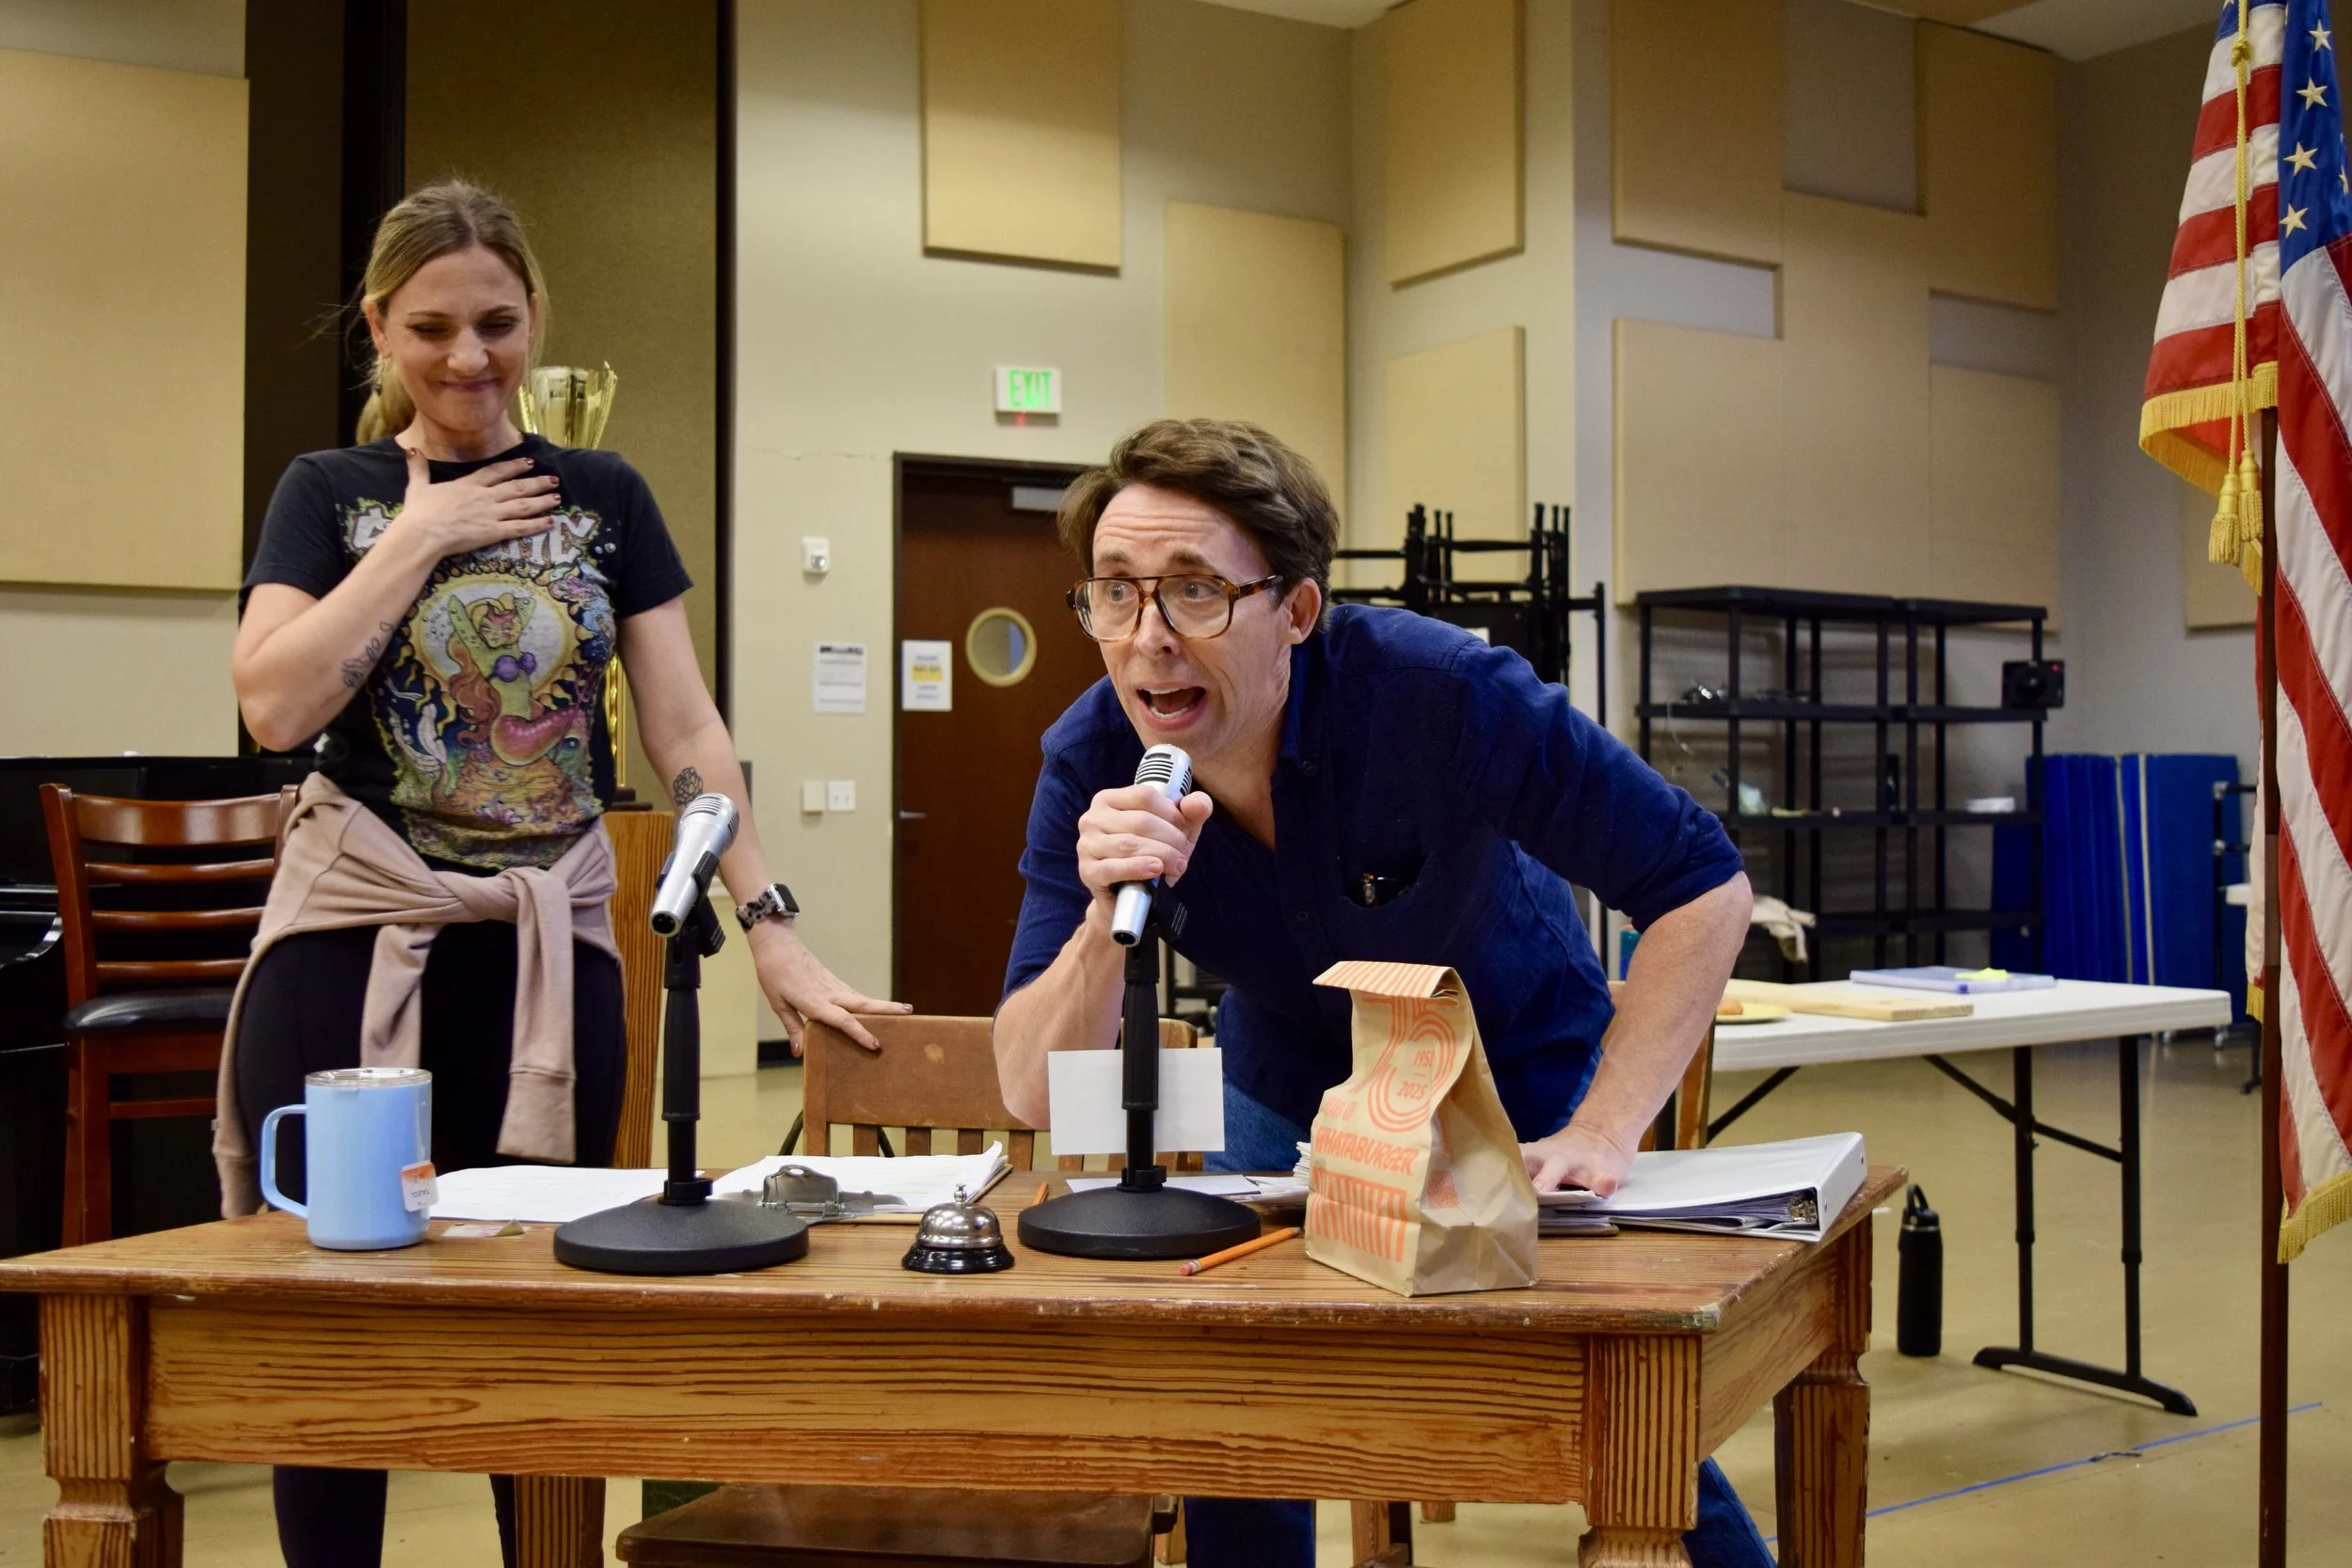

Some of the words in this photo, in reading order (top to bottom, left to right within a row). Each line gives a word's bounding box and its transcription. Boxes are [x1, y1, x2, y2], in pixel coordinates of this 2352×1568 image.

[1009, 370, 1053, 407] EXIT
[1396, 1081, 1428, 1100] 2025
[1314, 1127, 1420, 1175] WHATABURGER
